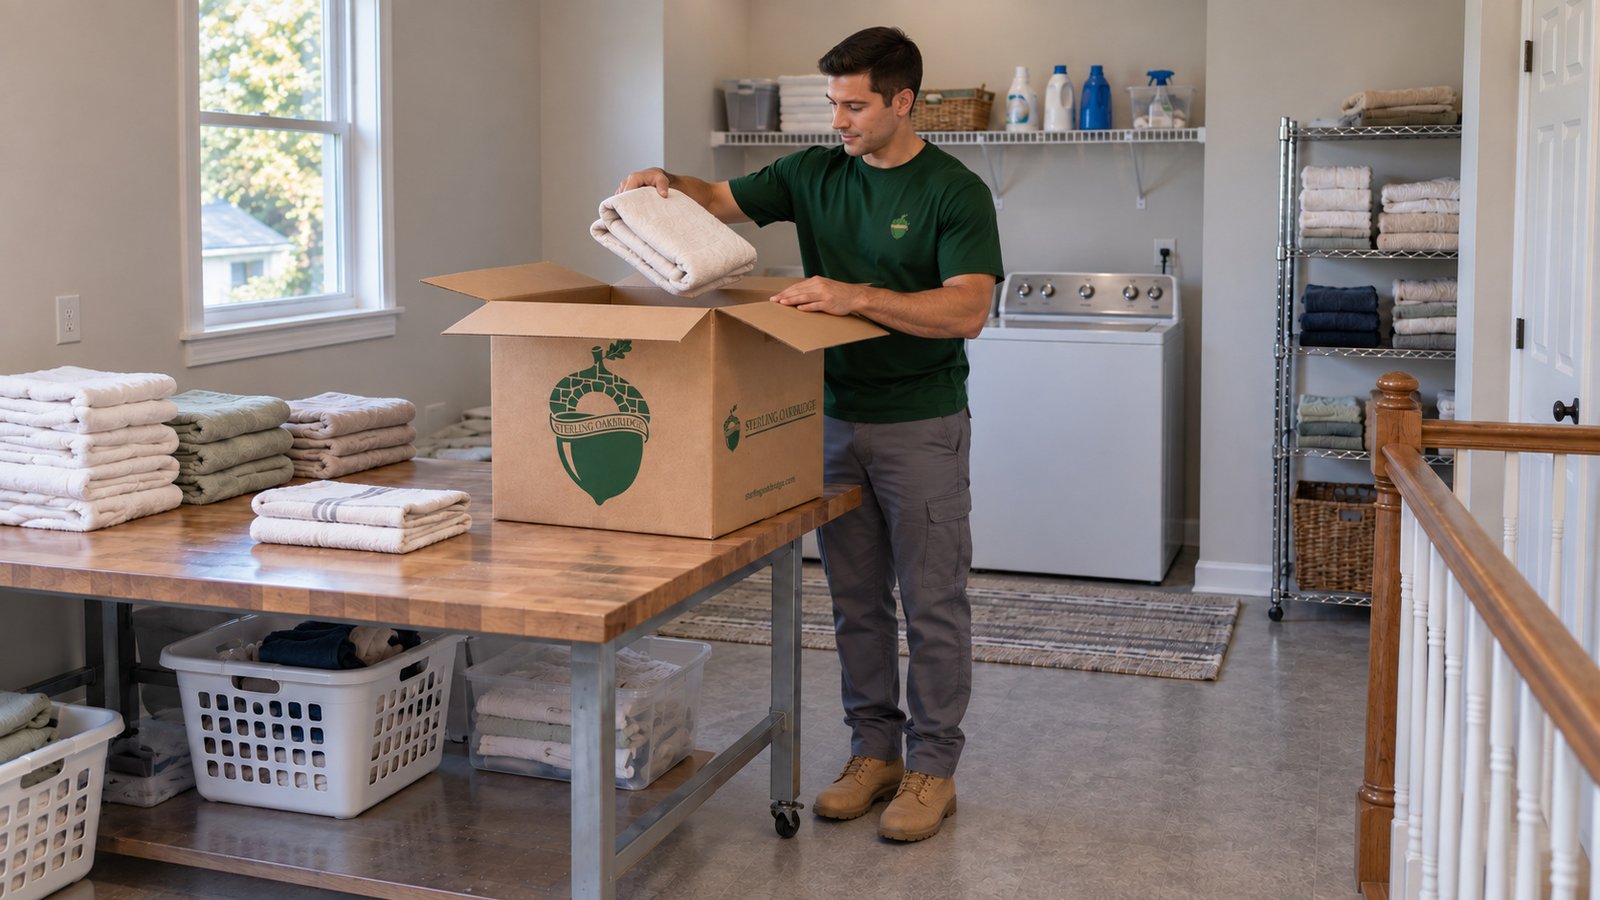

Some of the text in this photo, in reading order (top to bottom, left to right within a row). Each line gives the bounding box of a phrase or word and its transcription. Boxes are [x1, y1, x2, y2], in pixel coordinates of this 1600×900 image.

[554, 417, 645, 434] STERLING OAKBRIDGE
[745, 411, 778, 431] STERLING
